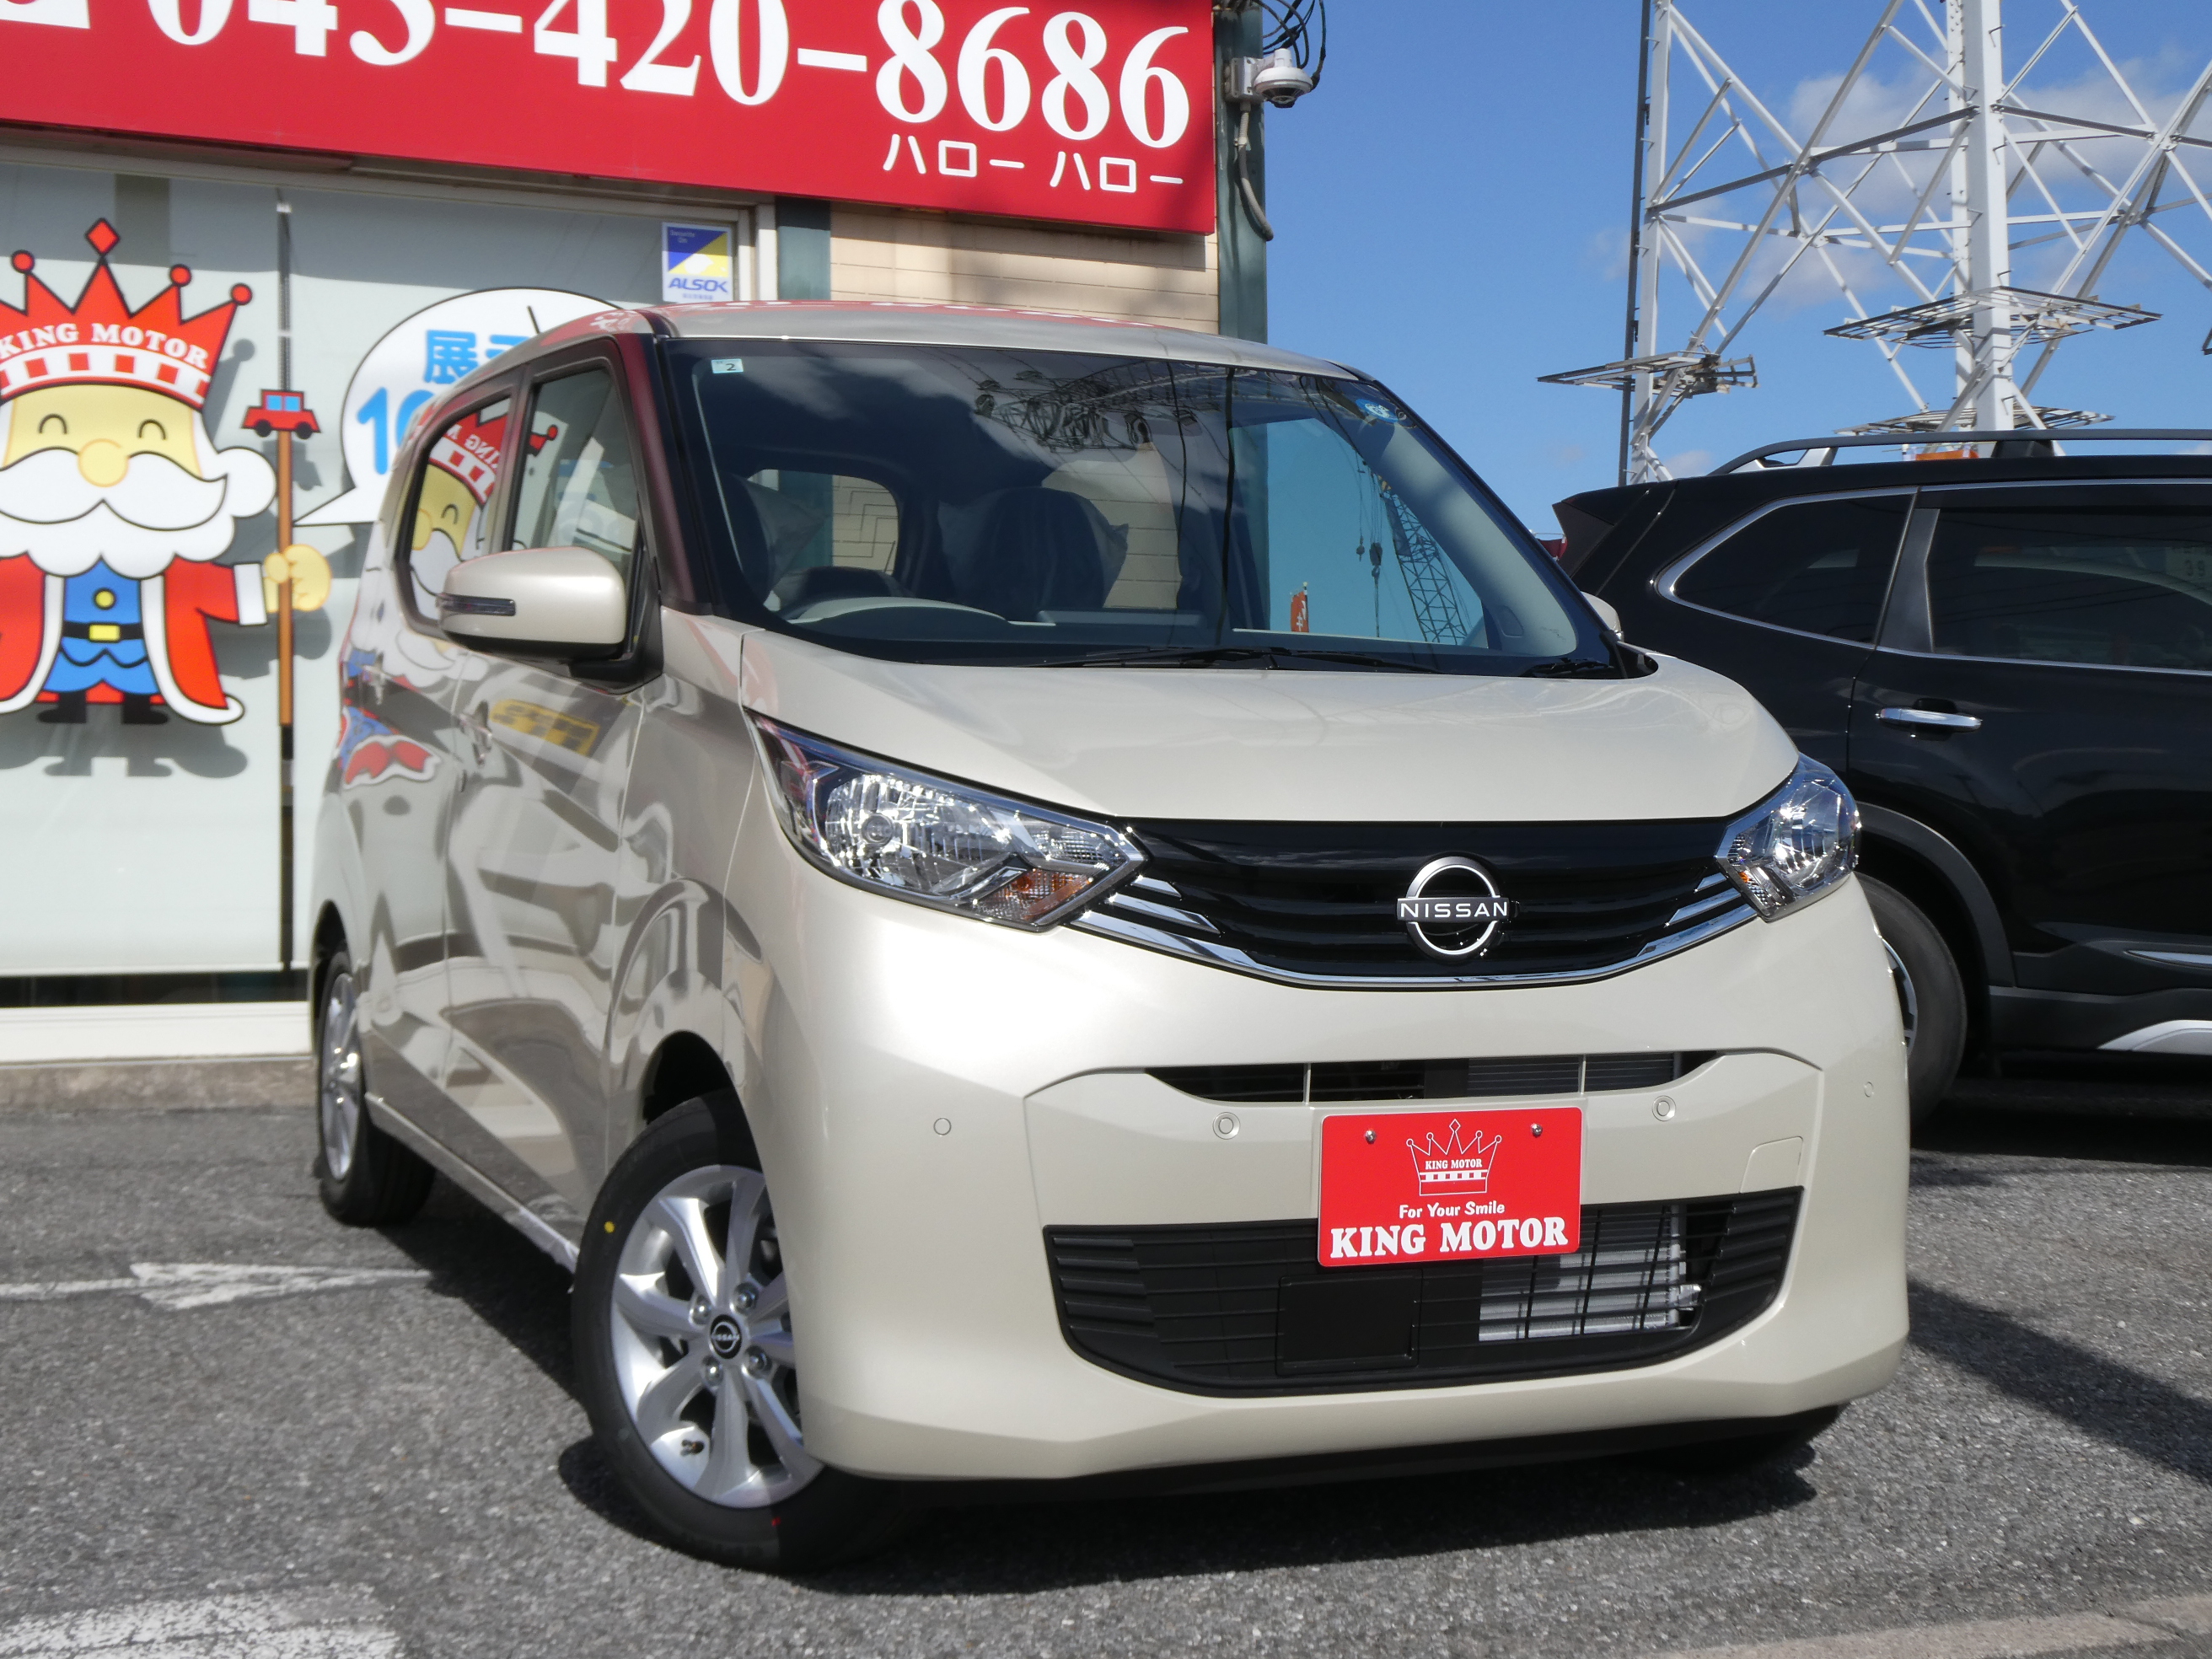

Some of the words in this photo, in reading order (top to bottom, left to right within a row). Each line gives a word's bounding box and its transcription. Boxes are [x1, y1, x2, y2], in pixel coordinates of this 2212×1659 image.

[883, 133, 1025, 178] ハロー
[1050, 151, 1184, 193] ハロー
[668, 277, 728, 293] ALSOK
[0, 323, 79, 359] KING
[91, 323, 209, 368] MOTOR
[1400, 902, 1507, 918] NISSAN
[1425, 1160, 1448, 1170] KING
[1451, 1158, 1483, 1169] MOTOR
[1399, 1204, 1423, 1219] For
[1426, 1202, 1461, 1217] Your
[1464, 1200, 1505, 1216] Smile
[1330, 1224, 1425, 1259] KING
[1440, 1216, 1568, 1253] MOTOR
